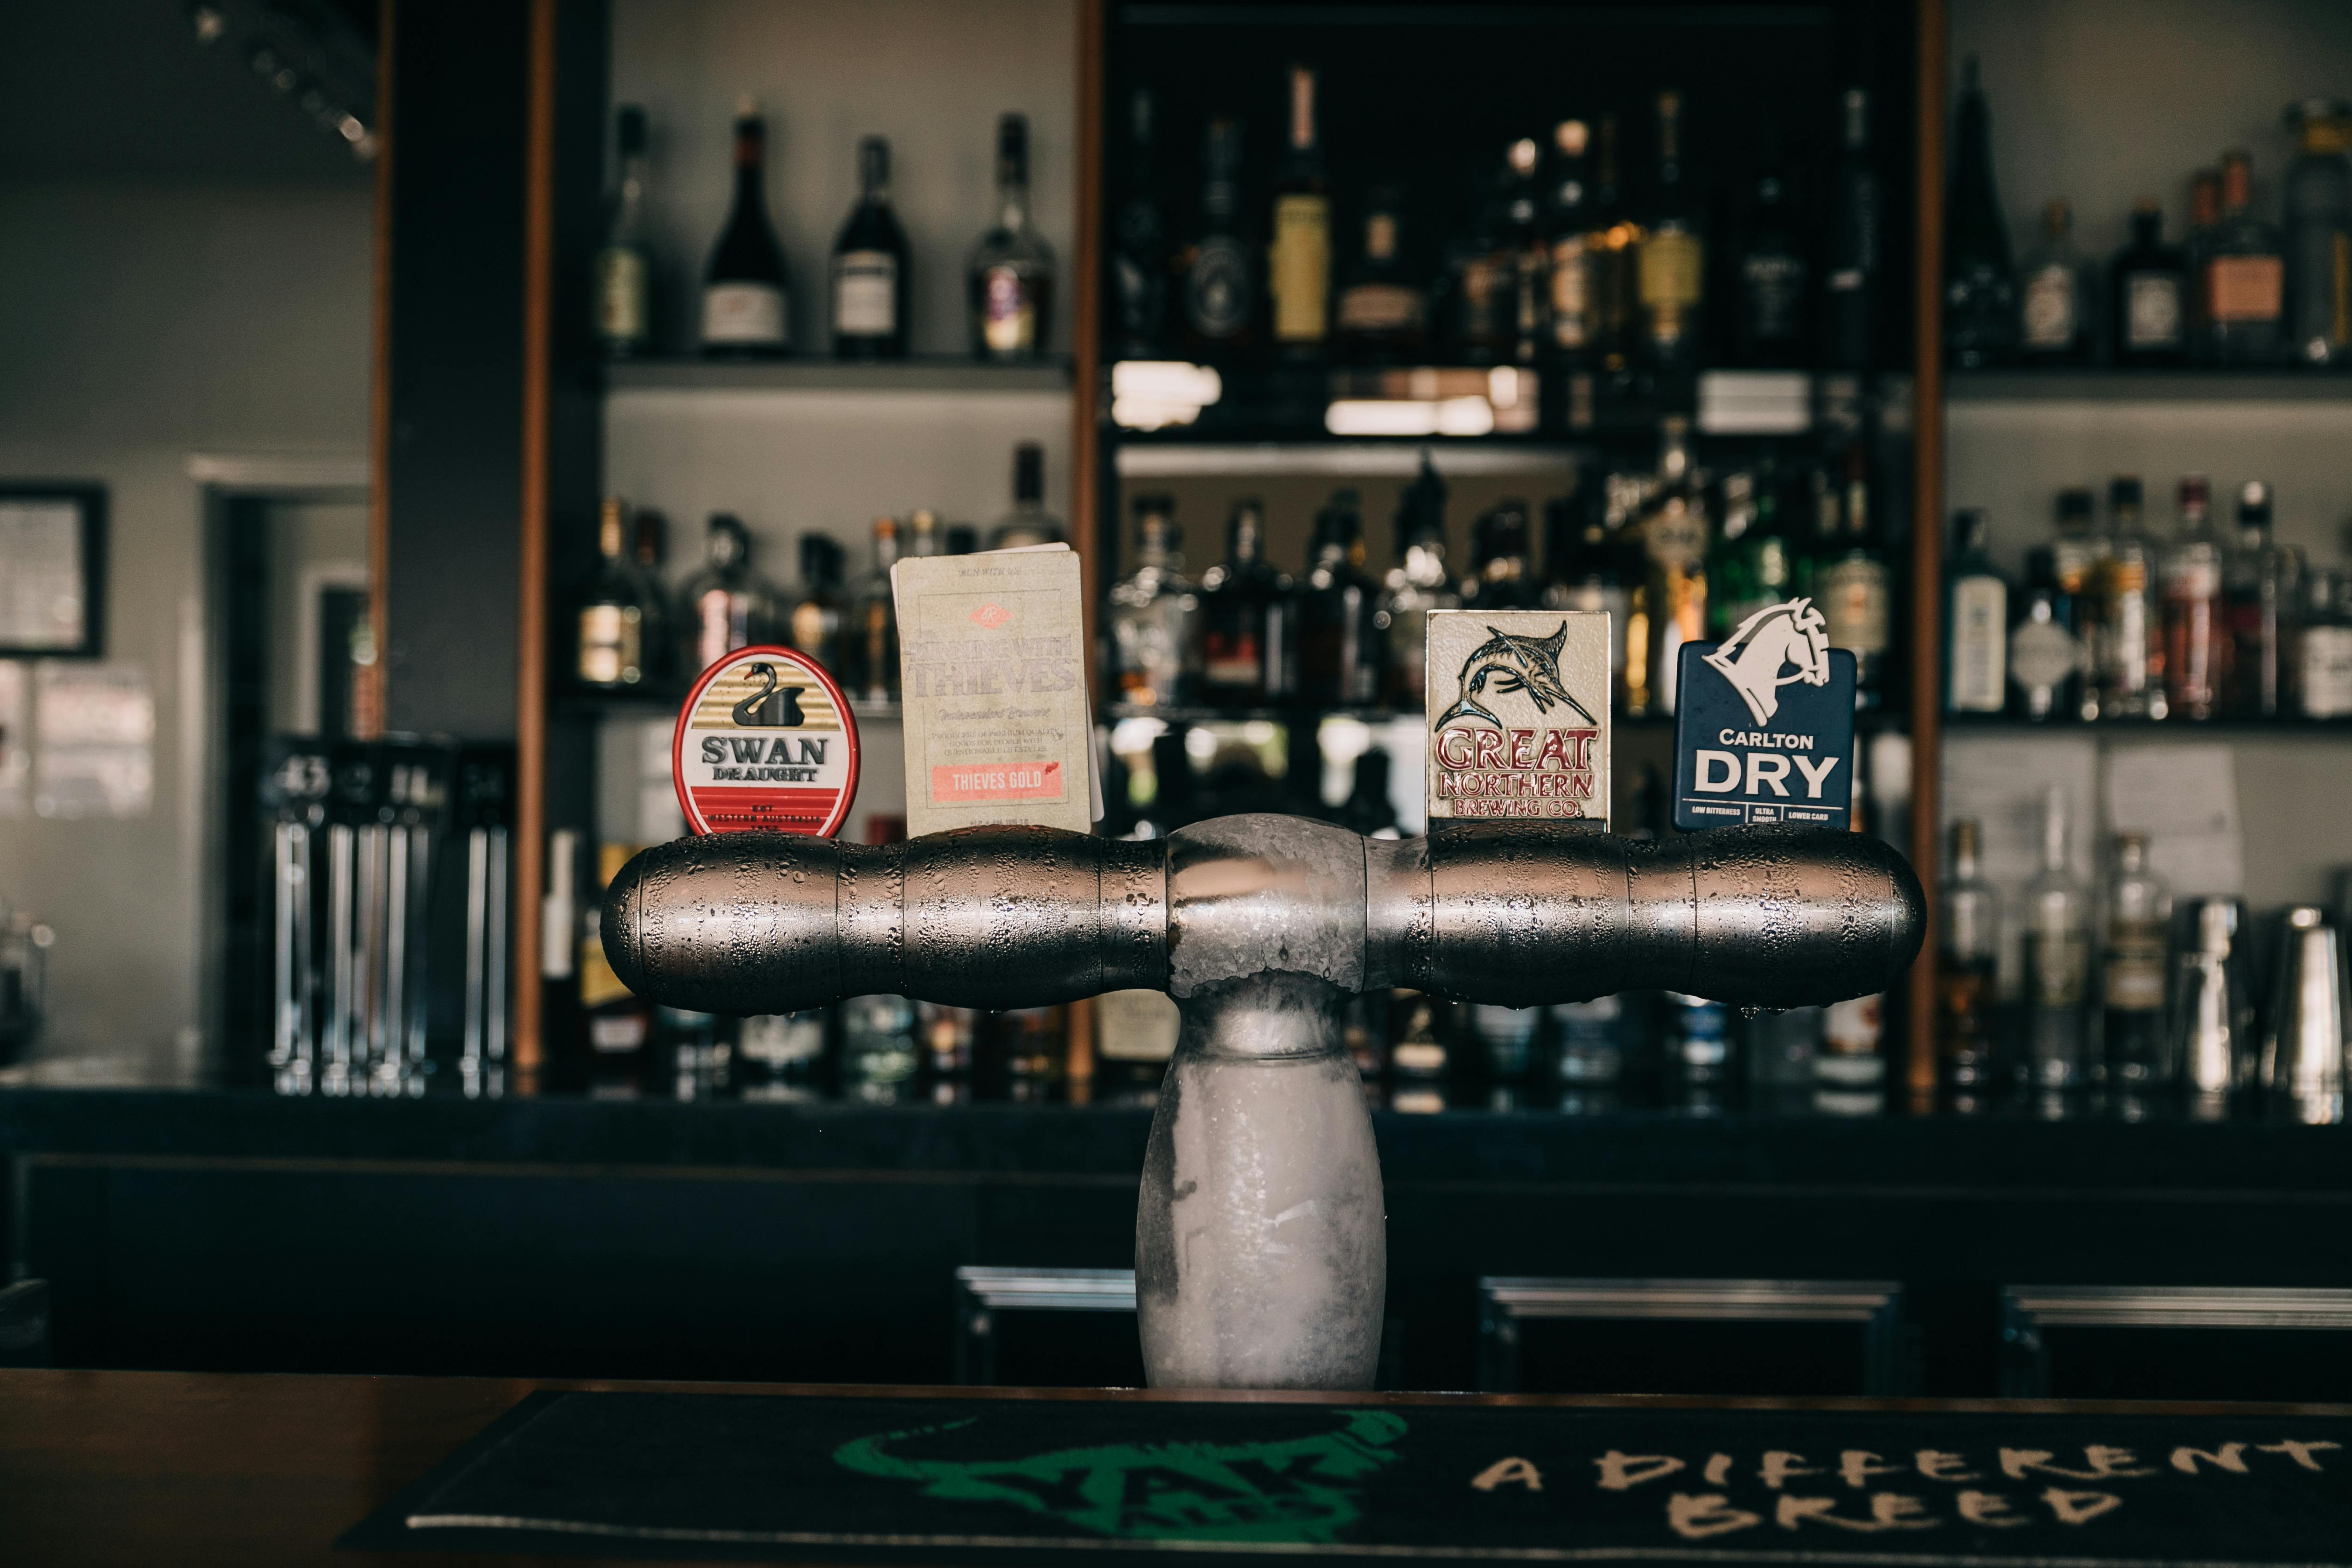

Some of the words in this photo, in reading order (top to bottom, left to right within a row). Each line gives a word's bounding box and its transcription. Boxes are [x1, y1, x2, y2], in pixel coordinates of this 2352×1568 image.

[909, 658, 1076, 697] THIEVES
[1436, 728, 1600, 771] GREAT
[1719, 728, 1814, 749] CARLTON
[702, 736, 829, 765] SWAN
[944, 748, 1001, 756] QUESTIONABLE
[712, 767, 819, 782] DRAUGHT
[952, 771, 1005, 791] THIEVES
[1009, 771, 1042, 788] GOLD
[1439, 772, 1594, 798] NORTHERN
[1693, 749, 1840, 798] DRY
[762, 814, 820, 823] AUSTRALIA
[1454, 798, 1542, 817] BREWING
[1547, 799, 1582, 817] CO.
[1706, 807, 1741, 816] BITTERNESS
[1471, 1456, 1543, 1490] A
[1593, 1440, 2342, 1489] DIFFERENT
[1667, 1486, 2122, 1539] BREED
